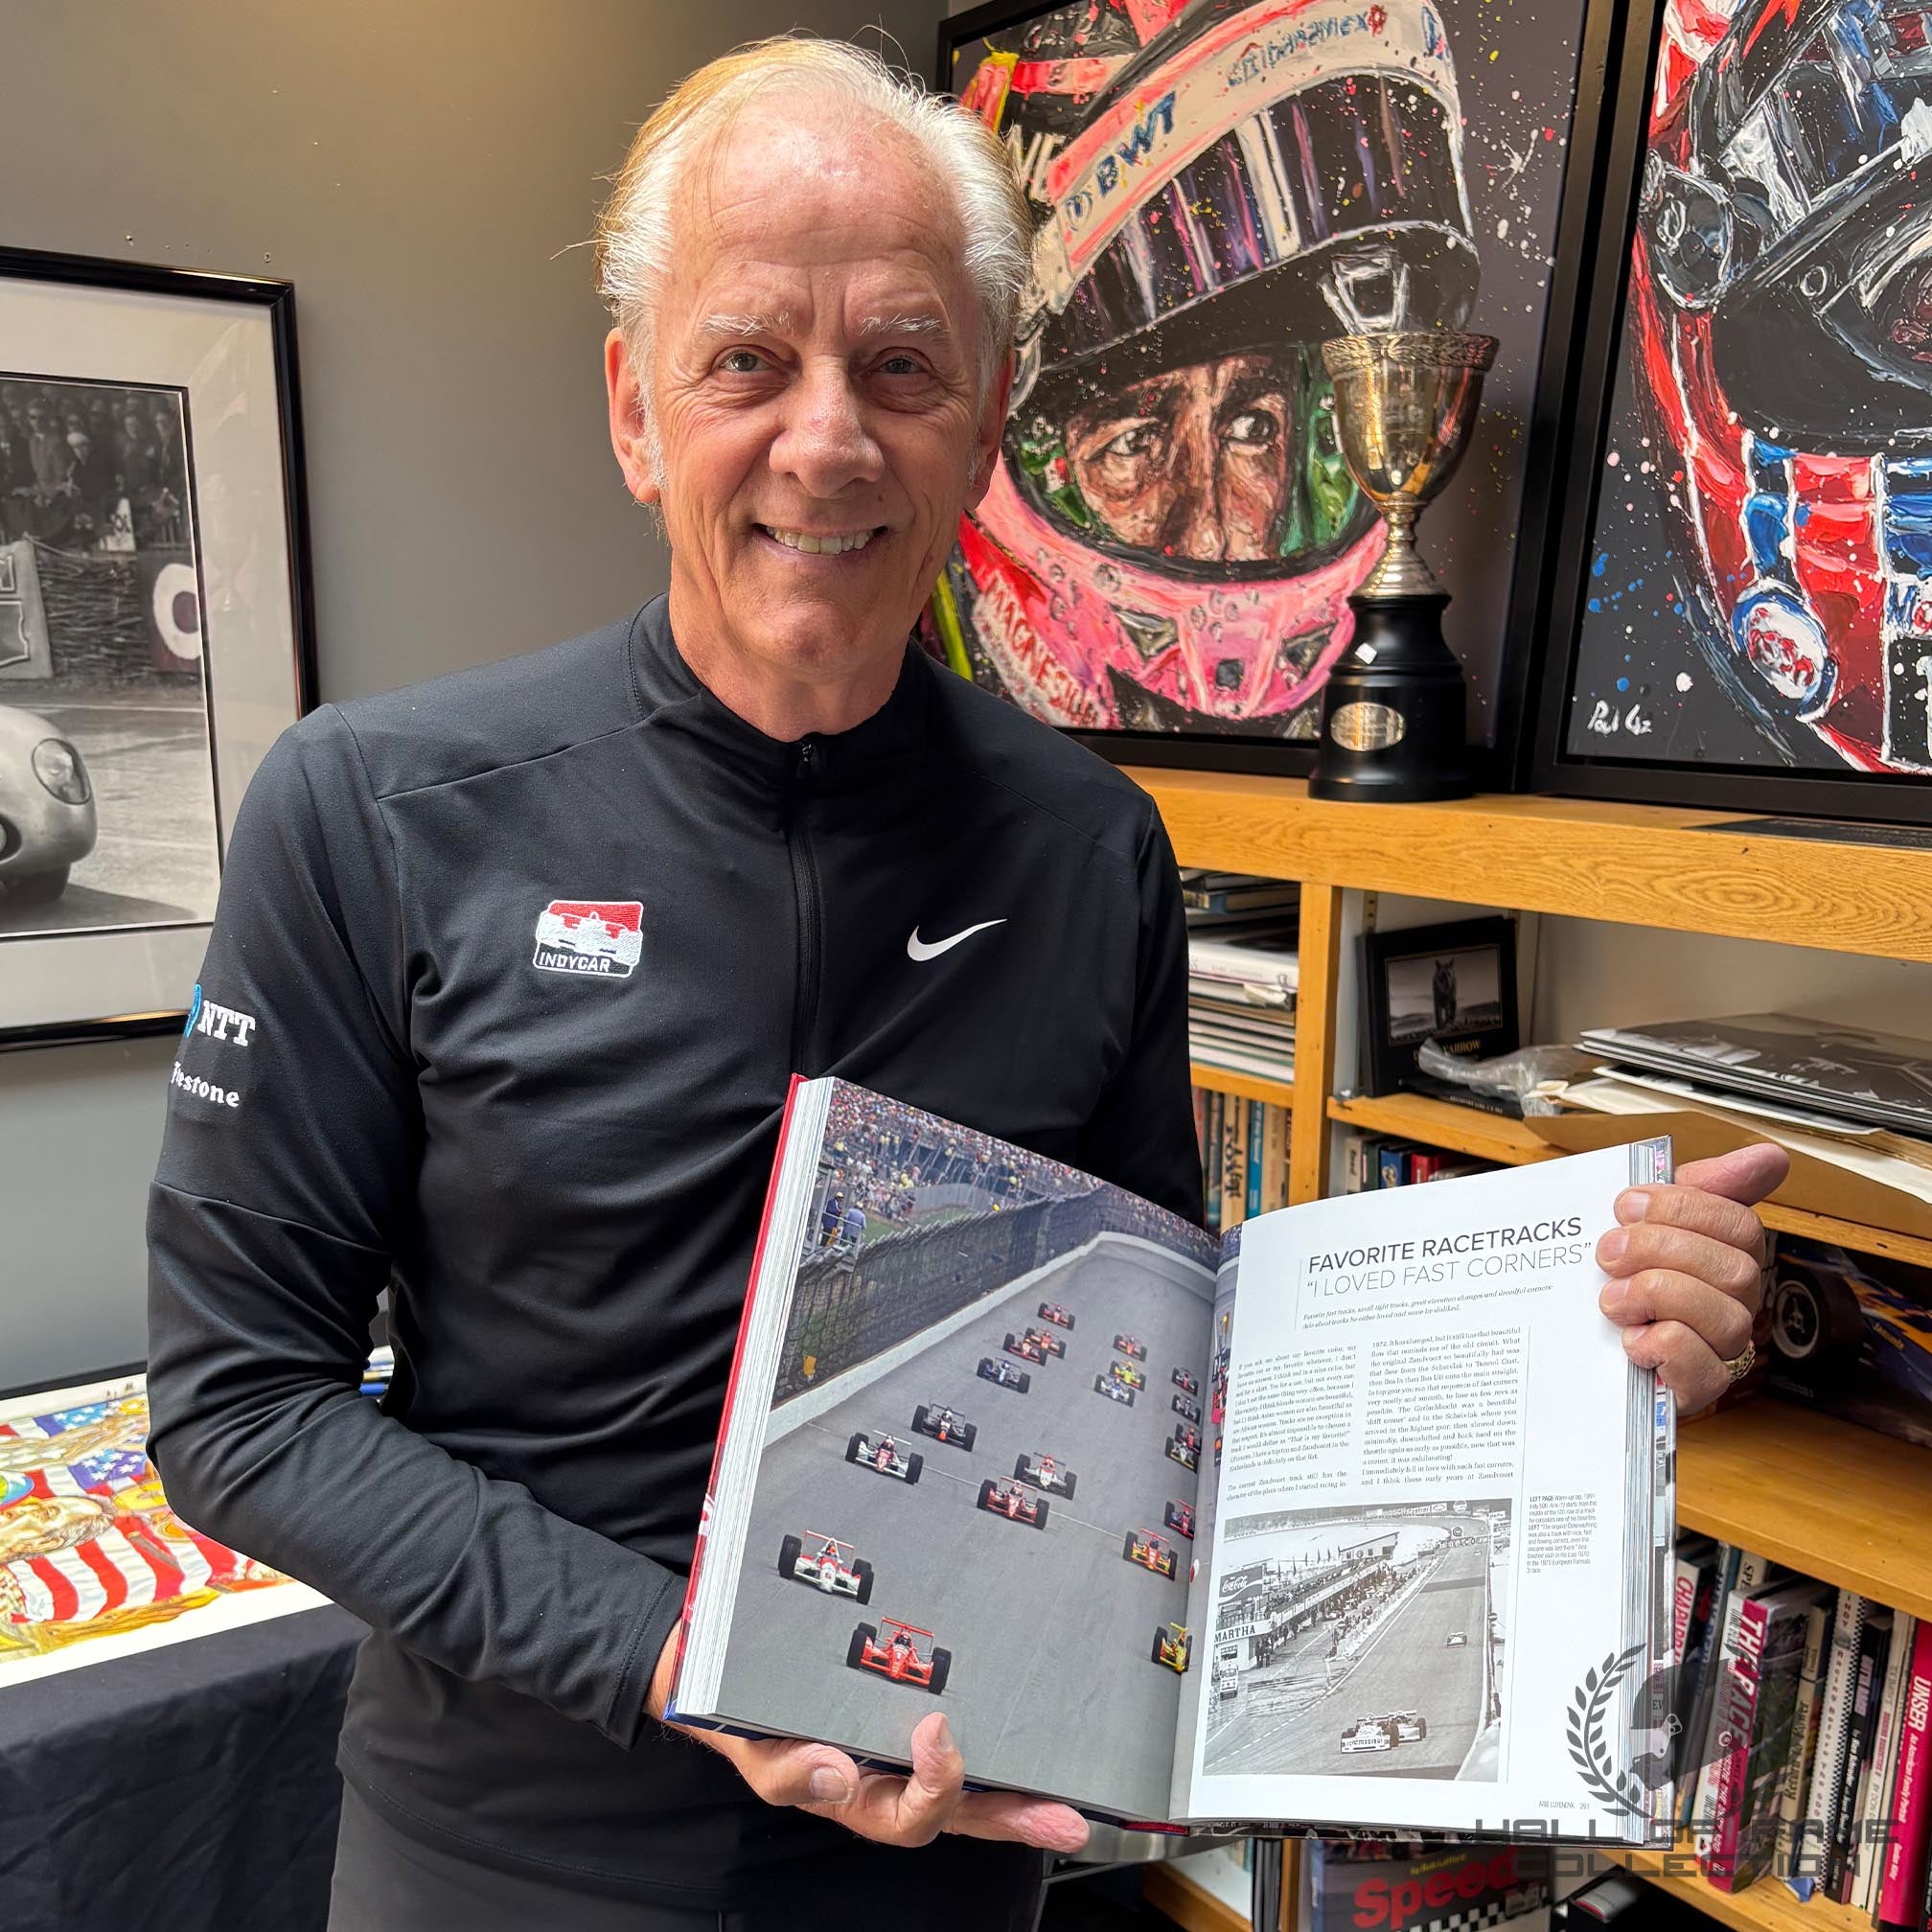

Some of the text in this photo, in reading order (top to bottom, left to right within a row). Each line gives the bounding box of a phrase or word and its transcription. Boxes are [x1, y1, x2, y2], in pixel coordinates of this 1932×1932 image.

[1095, 91, 1175, 197] BWT
[539, 952, 610, 973] INDYCAR
[196, 1000, 256, 1047] NTT
[1309, 1216, 1583, 1274] FAVORITE RACETRACKS
[1323, 1270, 1395, 1297] LOVED
[1403, 1260, 1460, 1286] FAST
[1735, 1615, 1763, 1665] THE
[1724, 1671, 1756, 1749] RACE
[1906, 1675, 1932, 1732] UNSER
[1352, 1846, 1518, 1930] Speed
